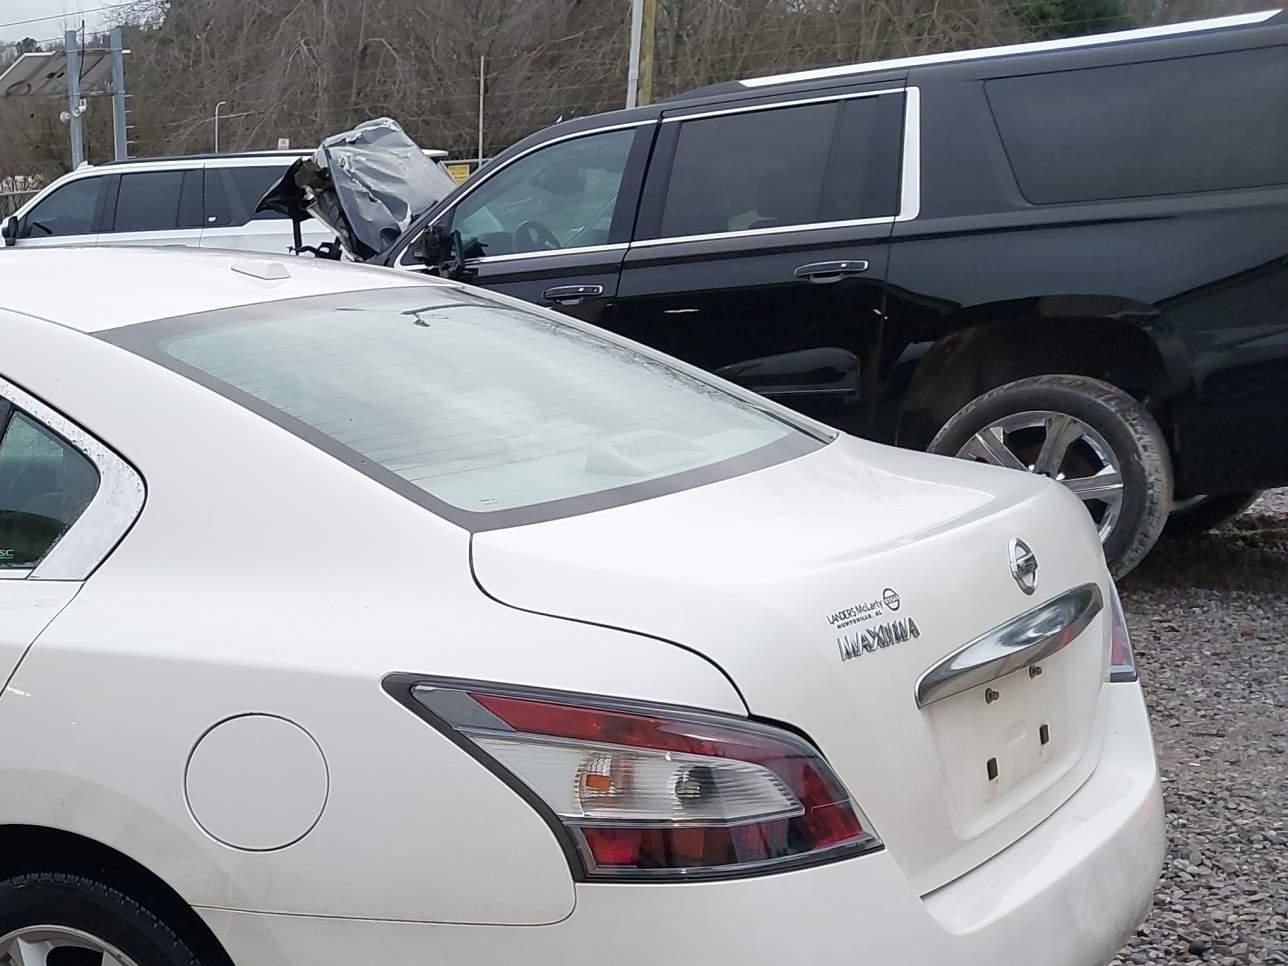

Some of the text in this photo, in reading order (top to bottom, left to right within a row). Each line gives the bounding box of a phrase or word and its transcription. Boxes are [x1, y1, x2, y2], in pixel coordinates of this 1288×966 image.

[826, 607, 857, 625] LANDERS
[854, 599, 884, 615] McLarty
[836, 613, 873, 630] HUNTSVILLE
[837, 616, 921, 662] MAXIMA
